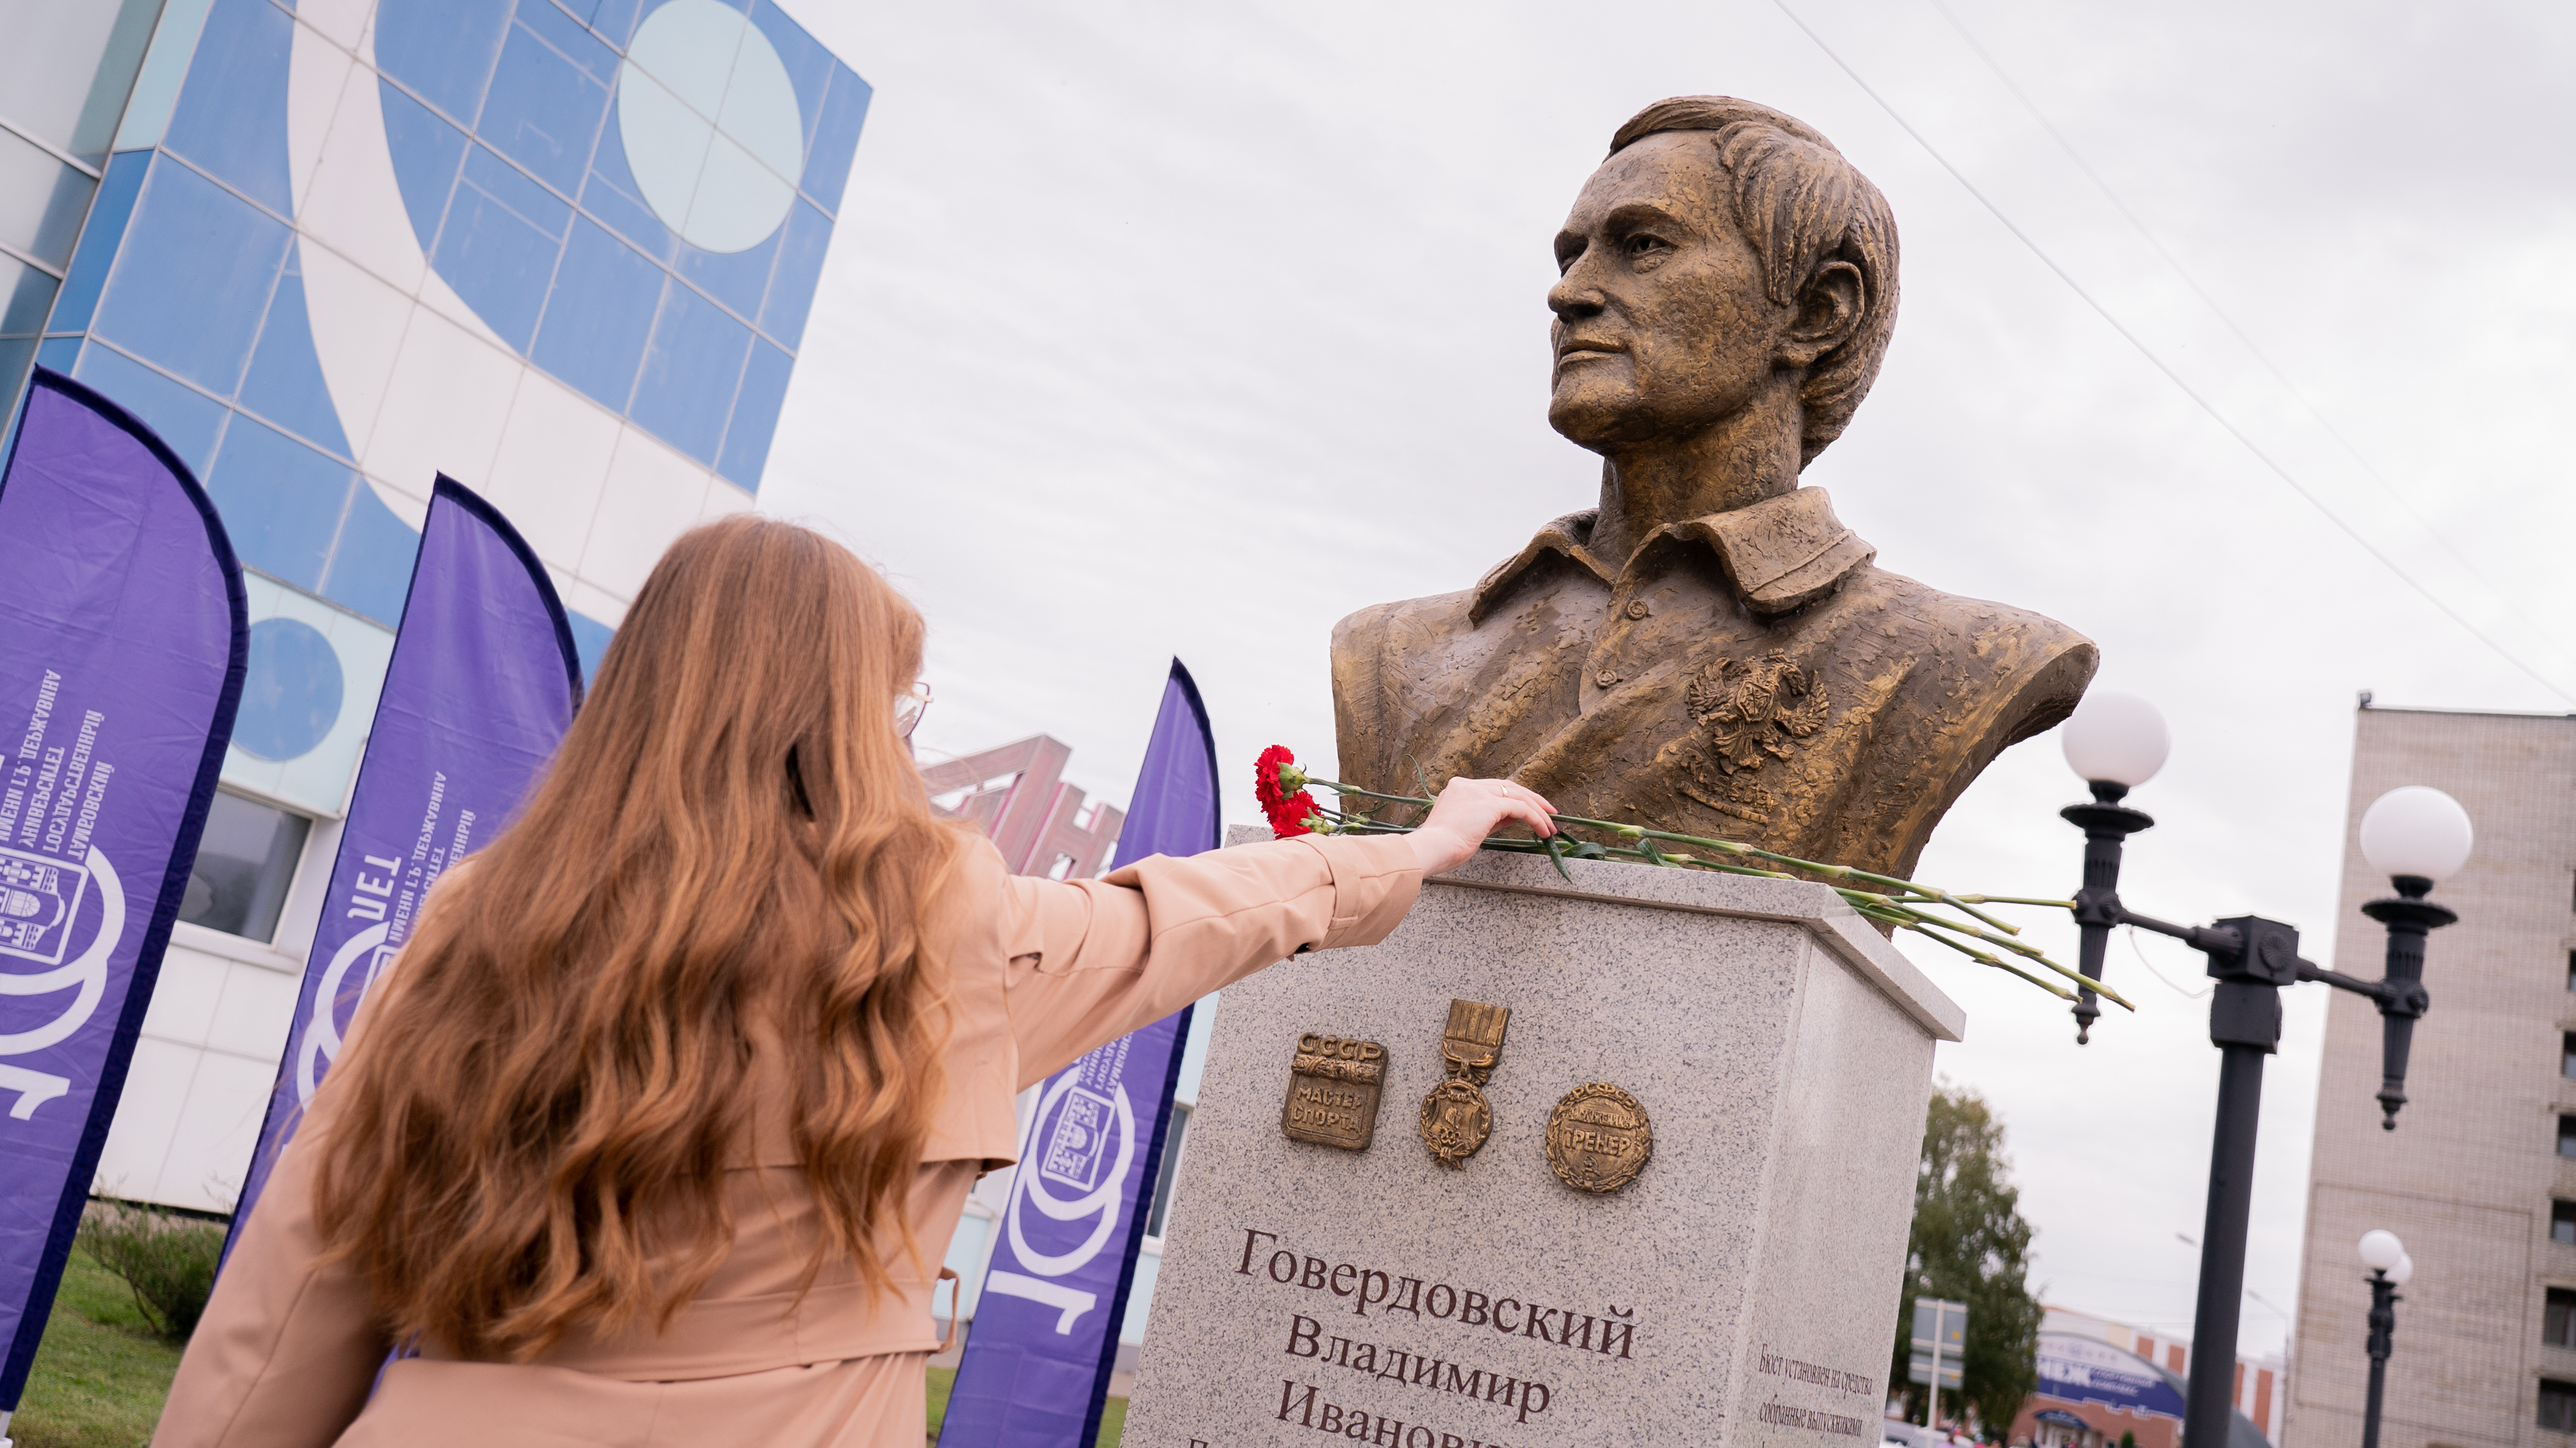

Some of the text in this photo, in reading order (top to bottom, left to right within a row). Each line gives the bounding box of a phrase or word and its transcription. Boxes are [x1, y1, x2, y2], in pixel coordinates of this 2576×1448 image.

[1298, 1033, 1383, 1062] СССР
[1293, 1104, 1361, 1134] СПОРТА
[1295, 1085, 1362, 1111] МАСТЕР
[1564, 1127, 1632, 1157] ТРЕНЕР
[1235, 1228, 1637, 1360] Говердовский
[1285, 1313, 1551, 1424] Владимир
[1759, 1343, 1872, 1399] Бюст установлен на средства
[1276, 1379, 1512, 1448] Иванов
[1759, 1394, 1863, 1440] собранные выпускниками
